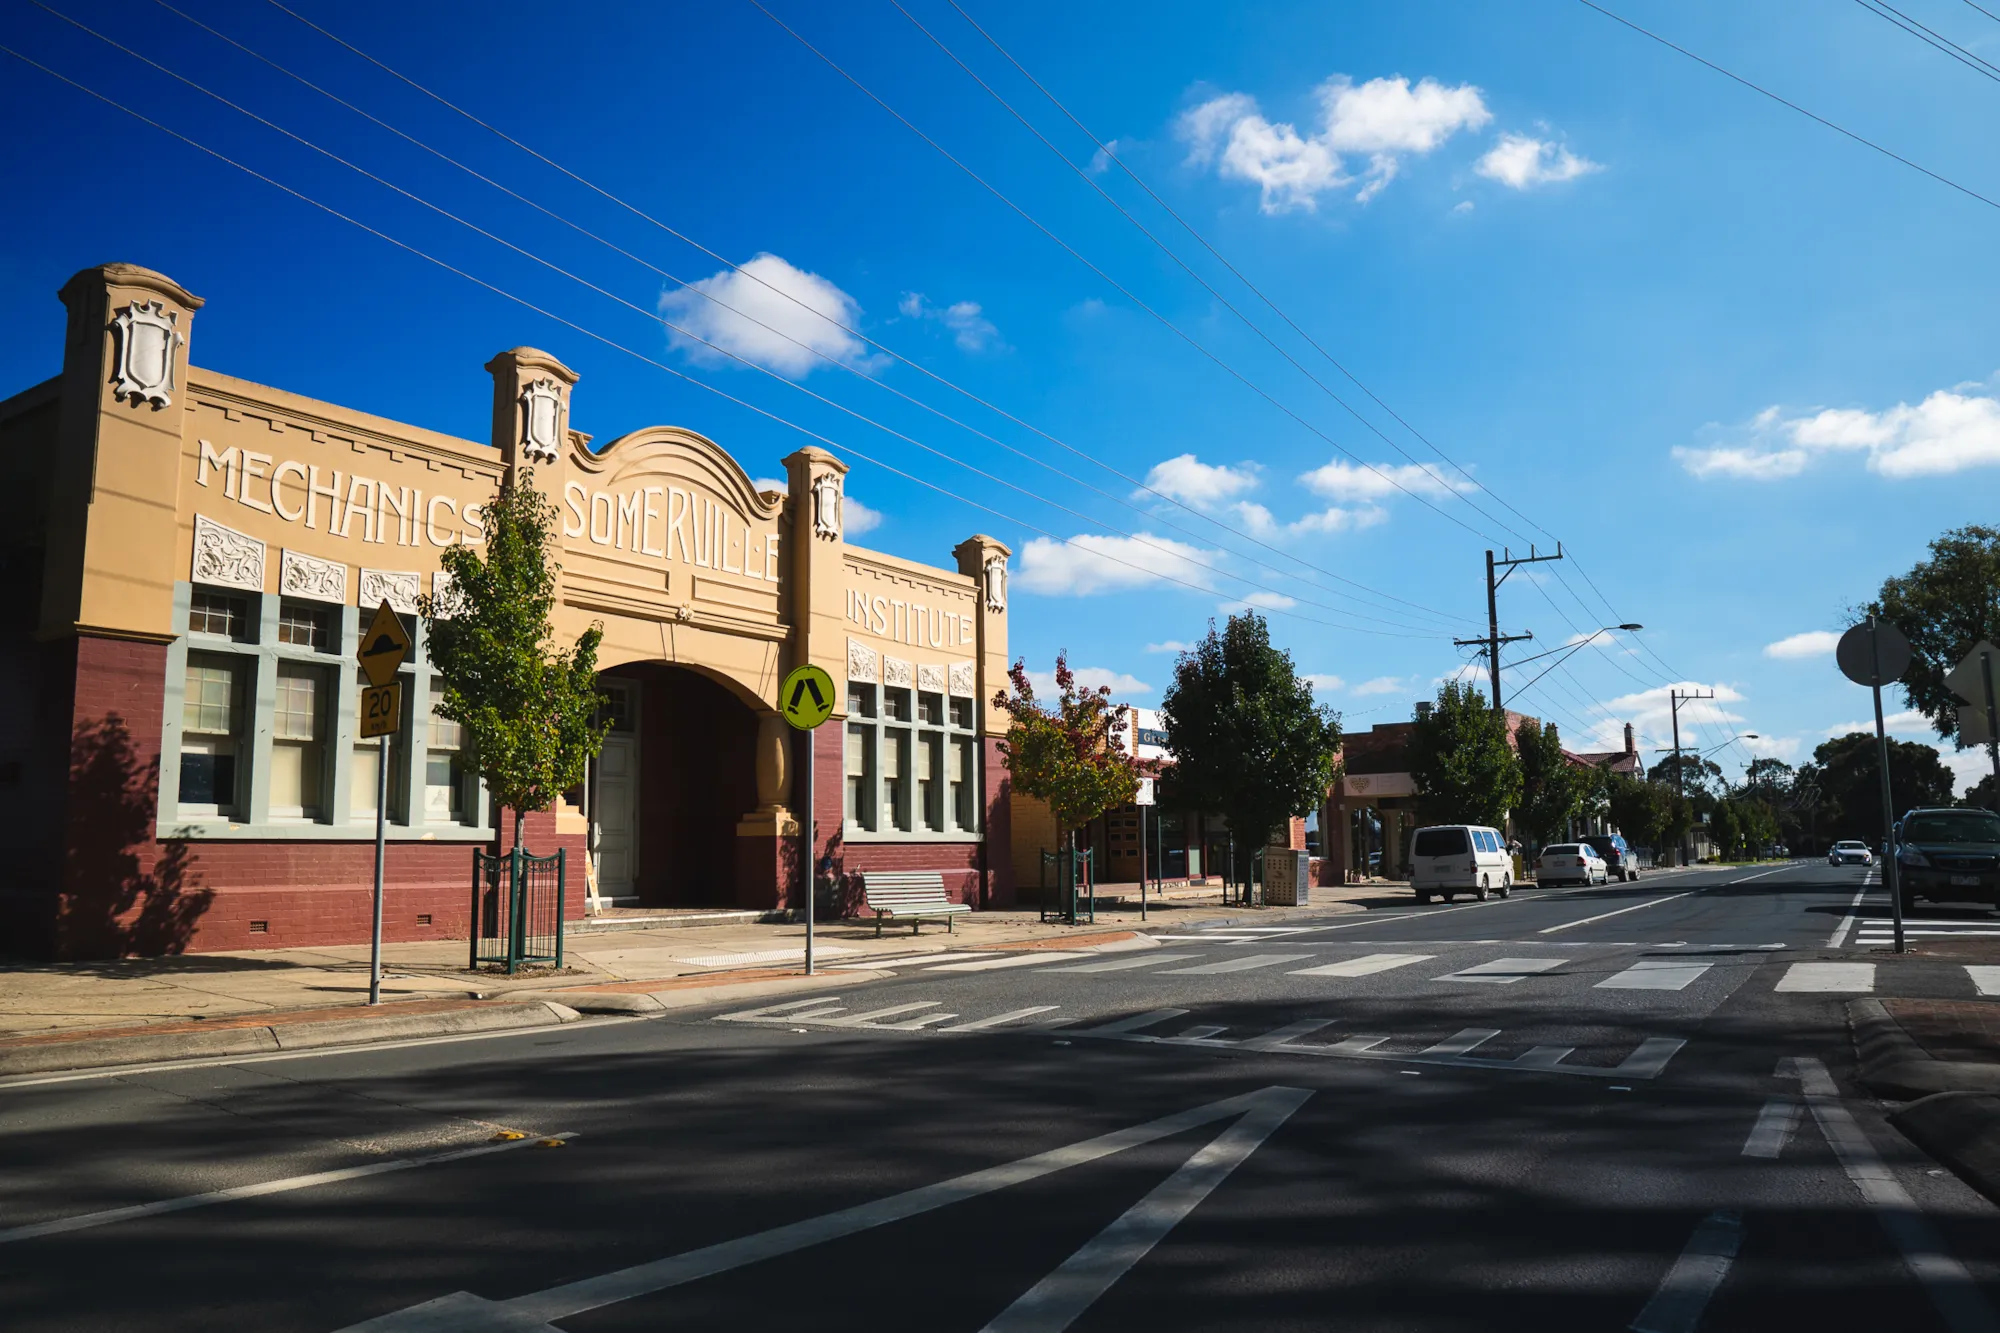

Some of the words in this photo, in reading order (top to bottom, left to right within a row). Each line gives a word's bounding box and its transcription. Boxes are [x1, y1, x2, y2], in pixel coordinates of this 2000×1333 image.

[195, 439, 487, 548] MECHANICS
[846, 588, 973, 648] INSTITUTE
[369, 690, 391, 718] 20
